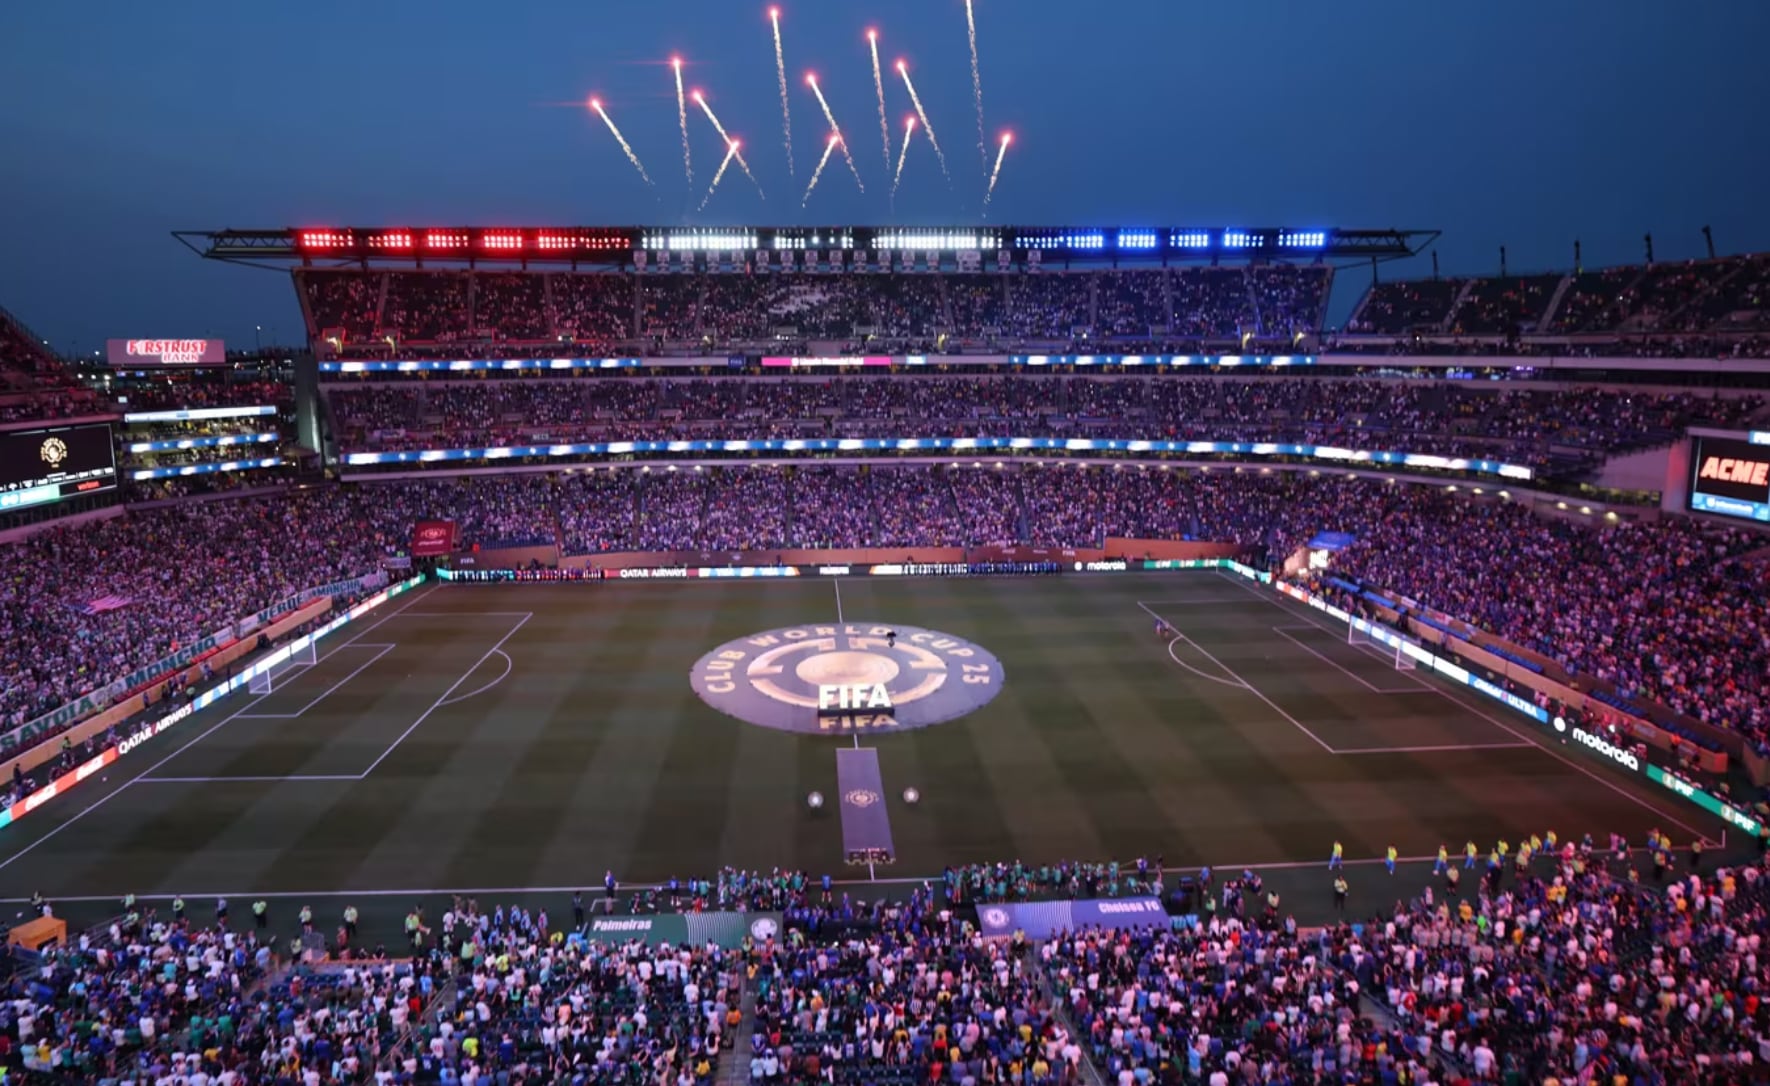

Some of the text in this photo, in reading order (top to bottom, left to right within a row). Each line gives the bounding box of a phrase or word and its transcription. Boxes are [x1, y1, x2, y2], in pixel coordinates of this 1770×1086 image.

[162, 352, 199, 363] BANK
[620, 568, 687, 578] QATAR AIRWAYS
[1087, 561, 1126, 571] motorola
[704, 625, 990, 693] CLUB WORLD CUP 25
[818, 683, 892, 710] FIFA
[1508, 692, 1538, 716] ULTRA
[118, 702, 193, 754] QATAR AIRWAYS
[819, 713, 898, 730] FIFA
[1573, 727, 1638, 771] motorola
[1674, 779, 1694, 797] PIF
[1734, 811, 1755, 831] PIF
[1098, 900, 1160, 913] Chelsea FC
[593, 919, 652, 931] Palmeiras
